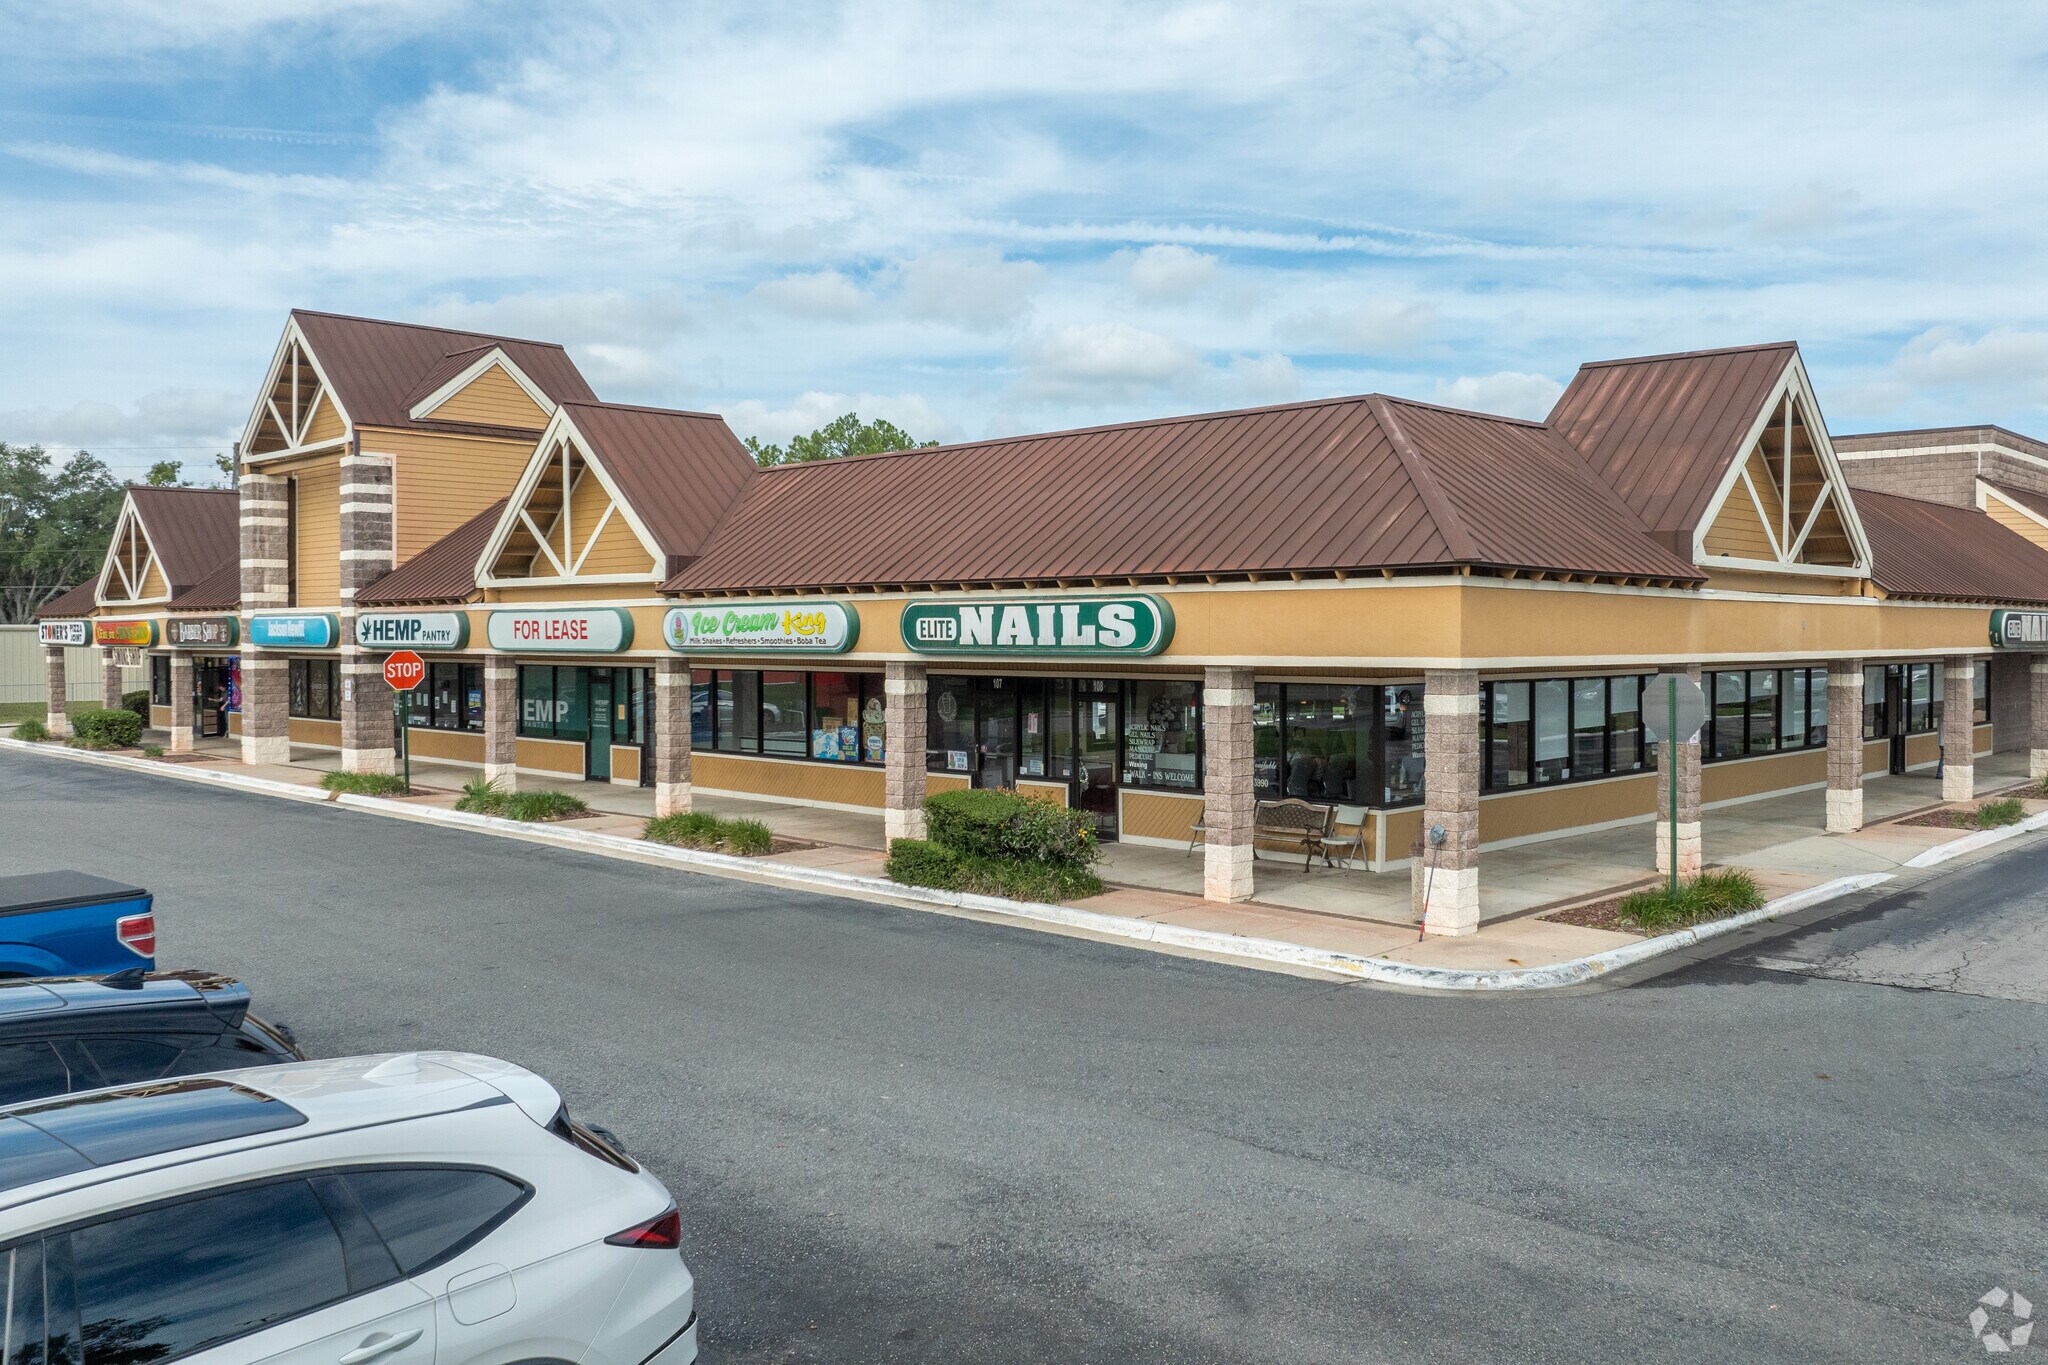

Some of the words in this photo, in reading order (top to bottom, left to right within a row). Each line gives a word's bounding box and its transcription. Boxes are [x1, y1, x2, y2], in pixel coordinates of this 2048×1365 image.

[69, 624, 83, 633] PIZZA
[373, 619, 422, 640] HEMP
[422, 630, 451, 641] PANTRY
[514, 620, 540, 639] FOR
[545, 619, 588, 640] LEASE
[691, 611, 720, 636] Ice
[722, 610, 779, 636] Cream
[782, 610, 826, 635] King
[919, 620, 952, 638] ELITE
[958, 604, 1137, 647] NAILS
[2021, 615, 2048, 641] NAI
[41, 624, 68, 640] STONER'S
[70, 634, 82, 642] JOINT
[387, 662, 421, 678] STOP
[1128, 760, 1148, 769] Waxing
[1165, 772, 1195, 783] WELCOME
